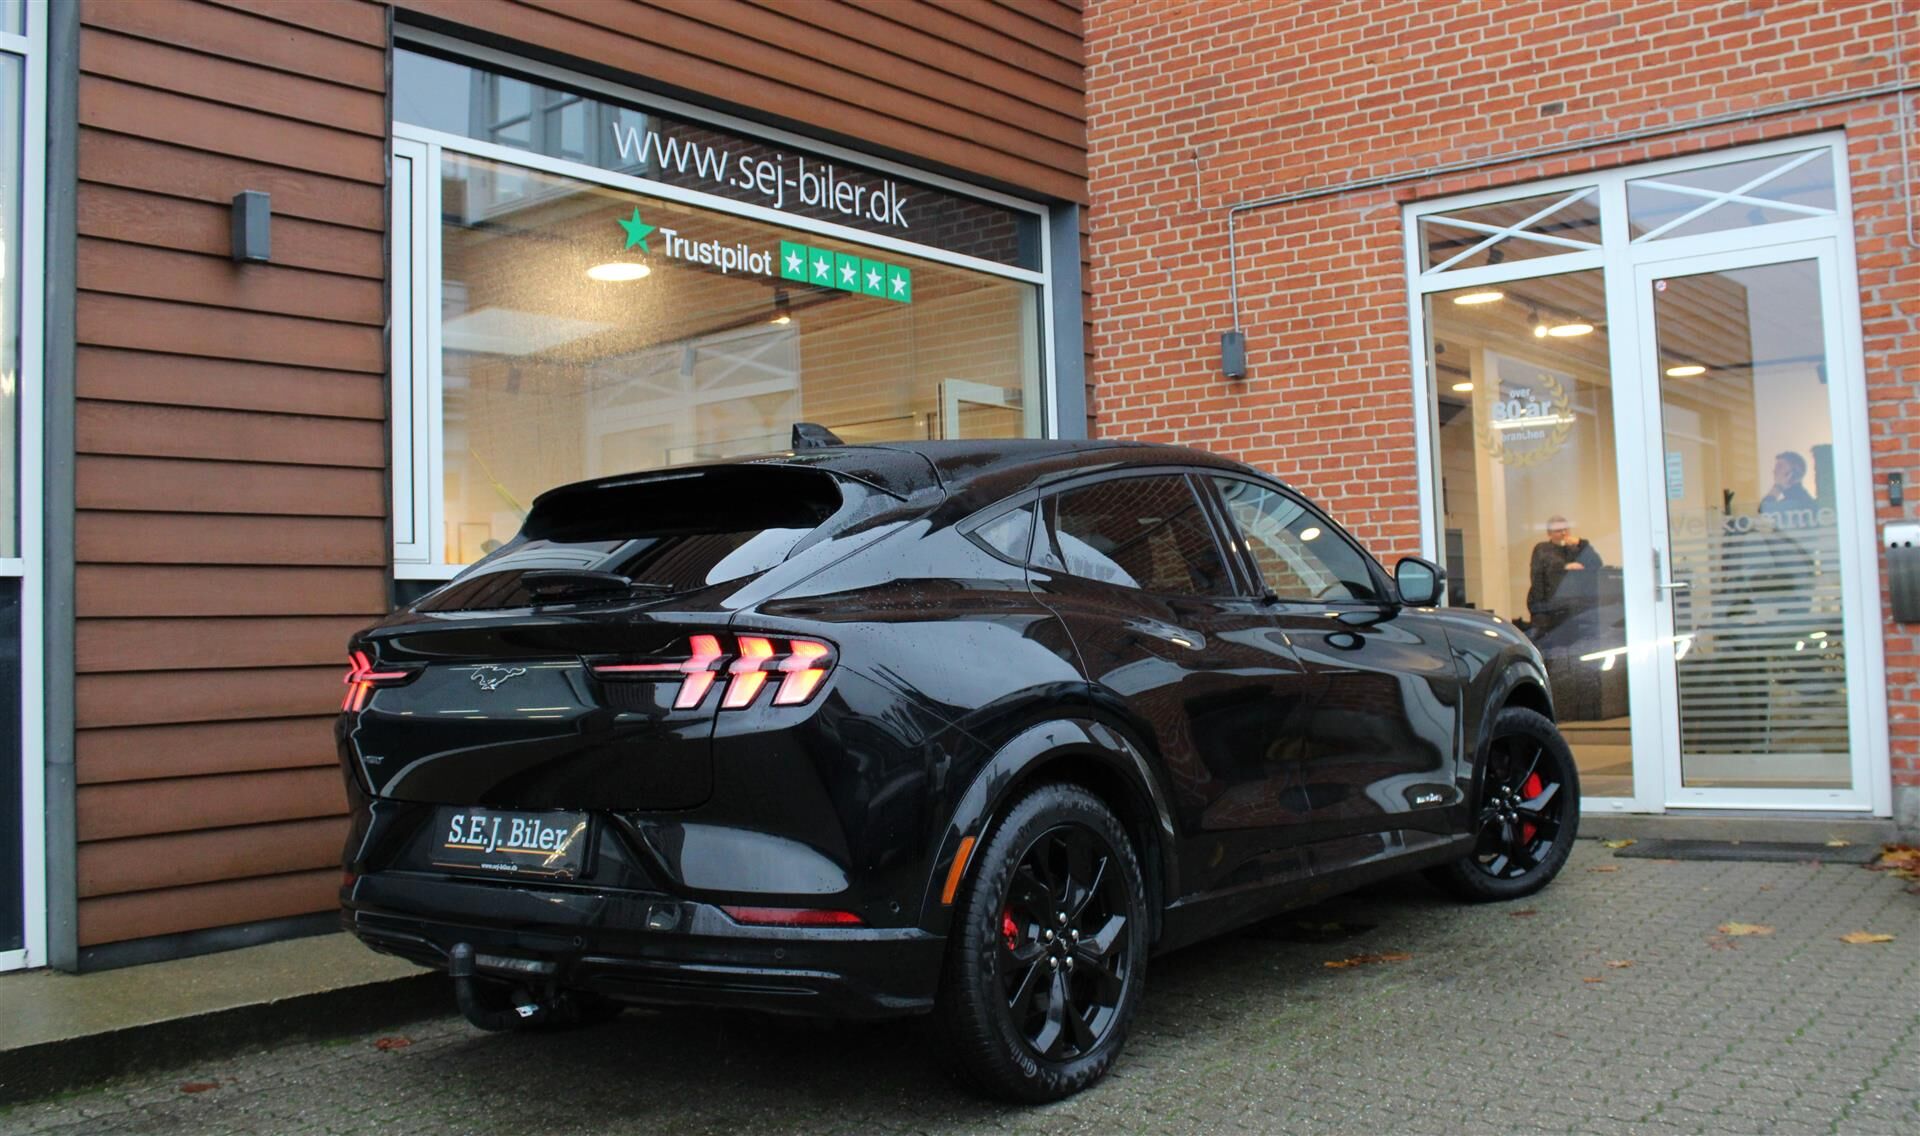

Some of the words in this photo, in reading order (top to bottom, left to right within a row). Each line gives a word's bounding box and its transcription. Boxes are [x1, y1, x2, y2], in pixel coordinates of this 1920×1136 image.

[613, 121, 909, 228] www.sej-biler.dk
[659, 227, 772, 276] Trustpilot
[1509, 387, 1531, 399] over
[448, 814, 502, 853] S.E.J.
[507, 819, 568, 850] Biler
